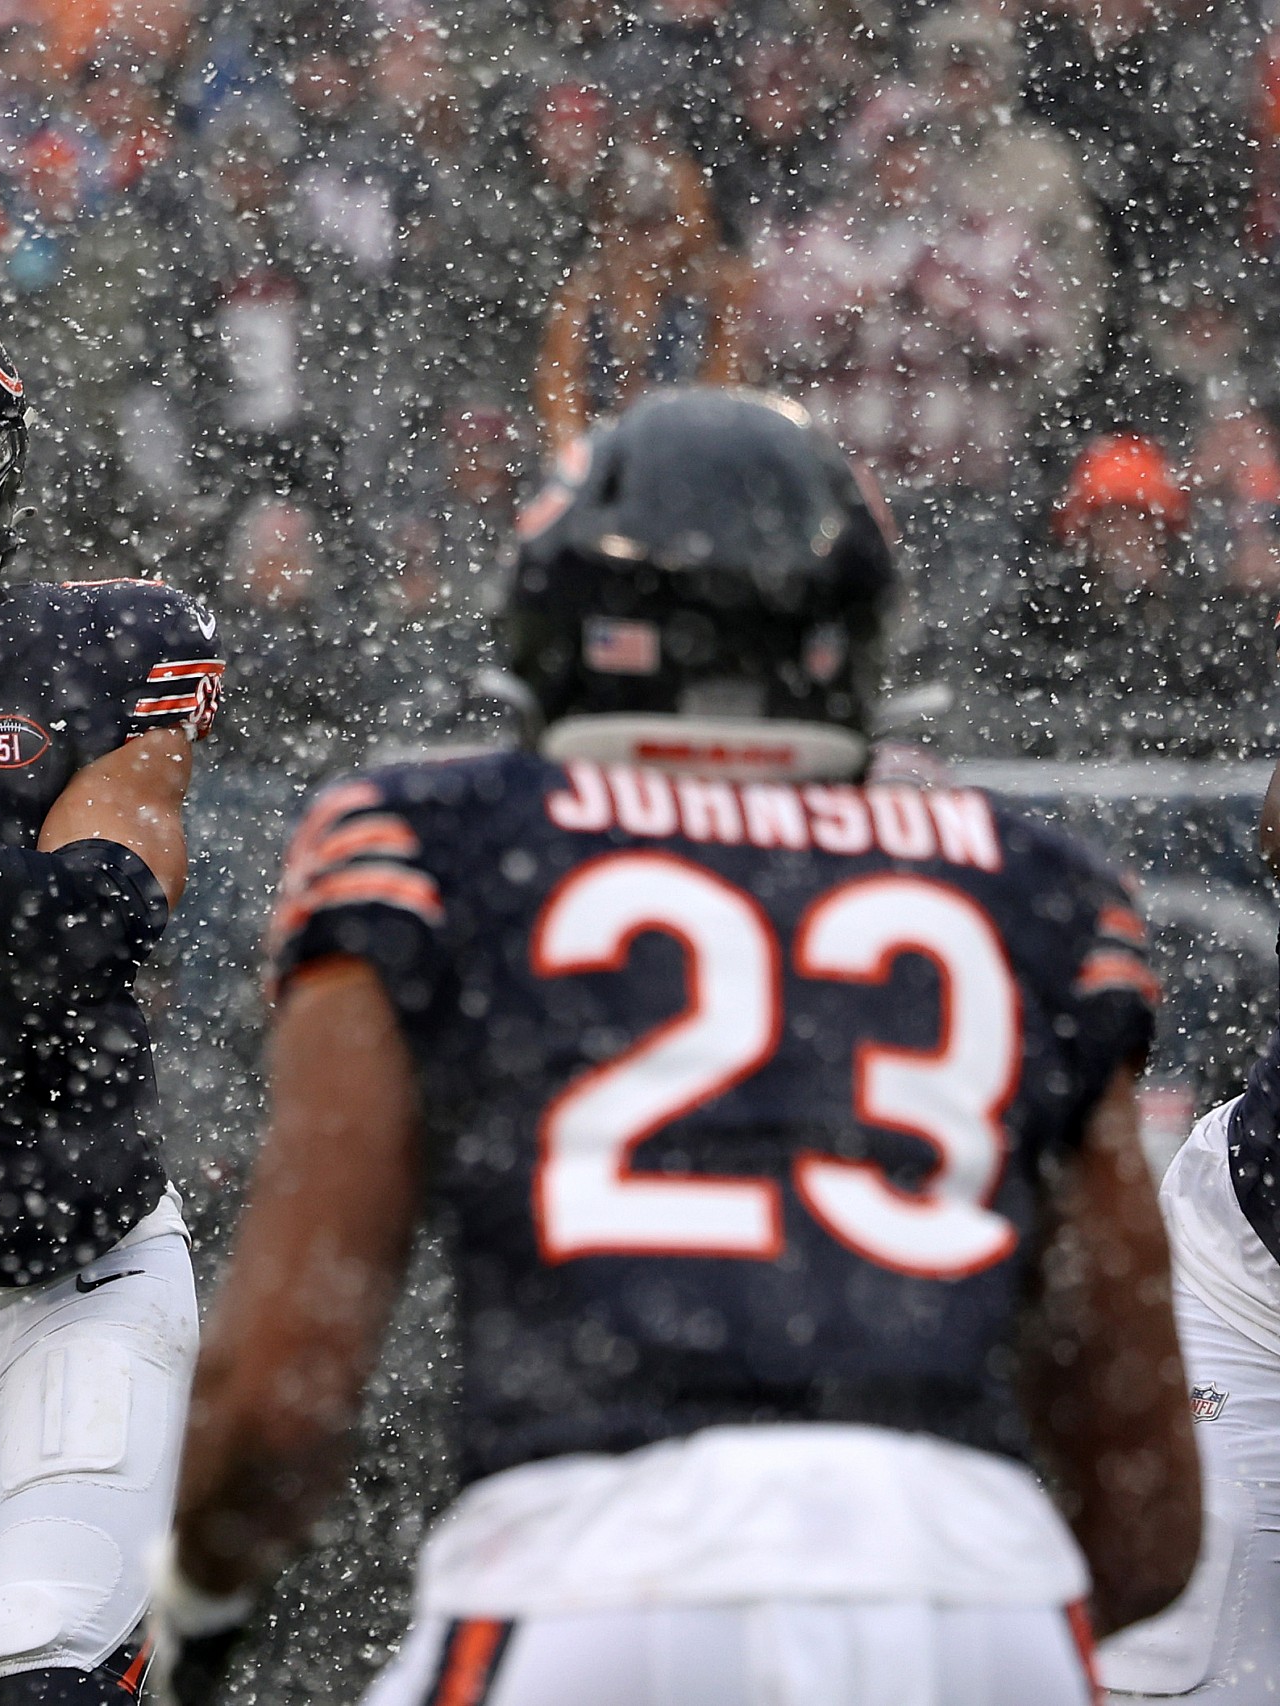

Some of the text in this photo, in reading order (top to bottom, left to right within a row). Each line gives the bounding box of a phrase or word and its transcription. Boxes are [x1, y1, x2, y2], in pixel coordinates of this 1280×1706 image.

[545, 758, 999, 872] JOHNSON
[530, 847, 1022, 1280] 23
[1190, 1399, 1214, 1416] NFL
